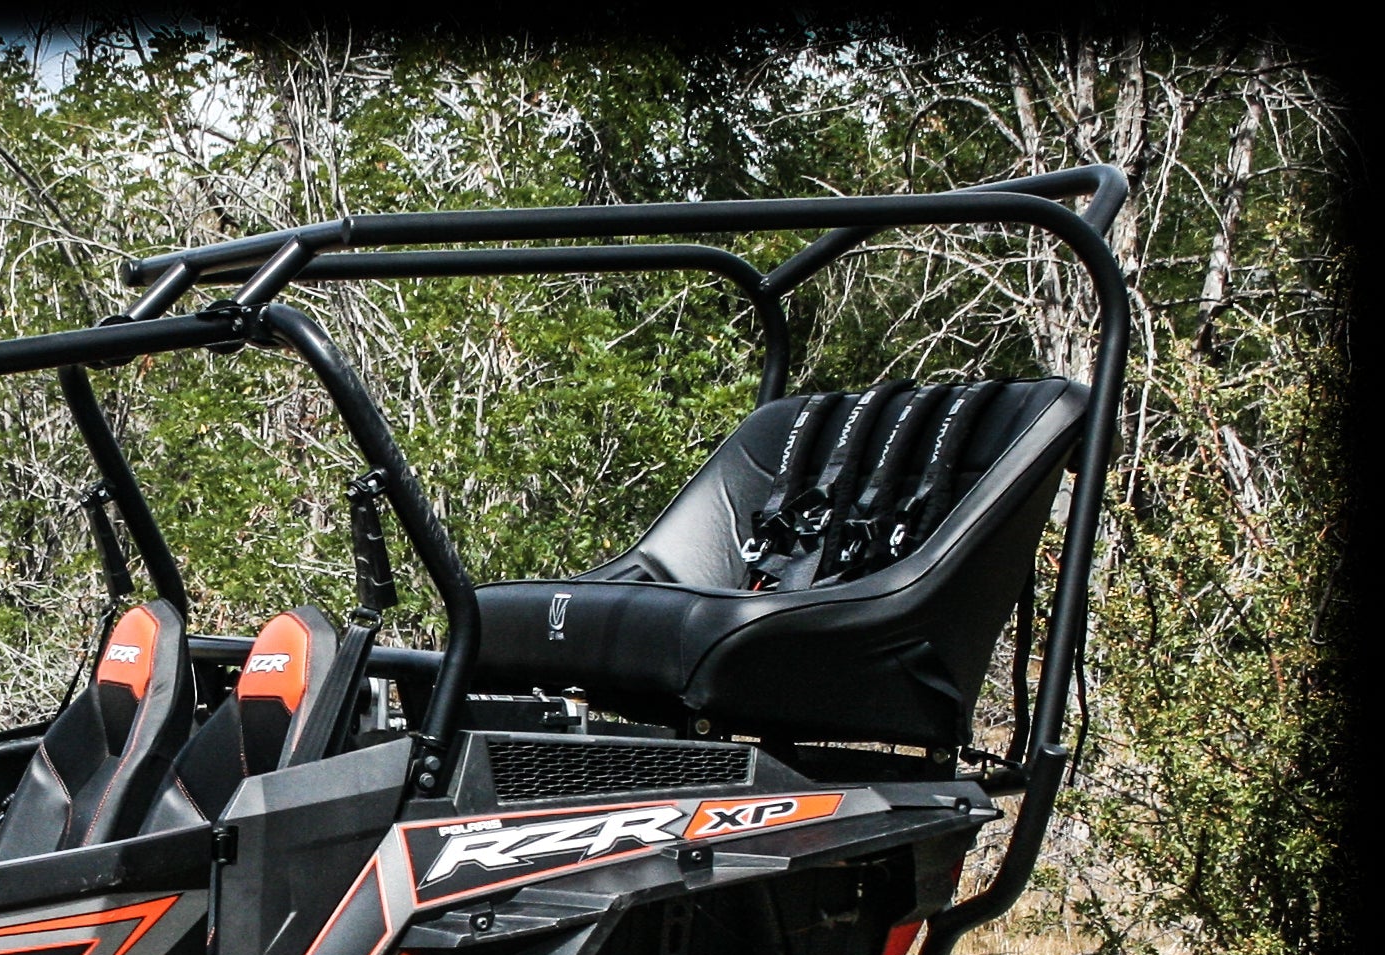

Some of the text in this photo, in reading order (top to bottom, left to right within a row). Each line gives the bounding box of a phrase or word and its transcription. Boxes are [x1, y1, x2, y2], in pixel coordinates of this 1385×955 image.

[105, 644, 141, 664] RZR
[245, 654, 291, 675] RZR
[439, 818, 503, 837] POLARIS
[418, 801, 797, 889] RZR XP
